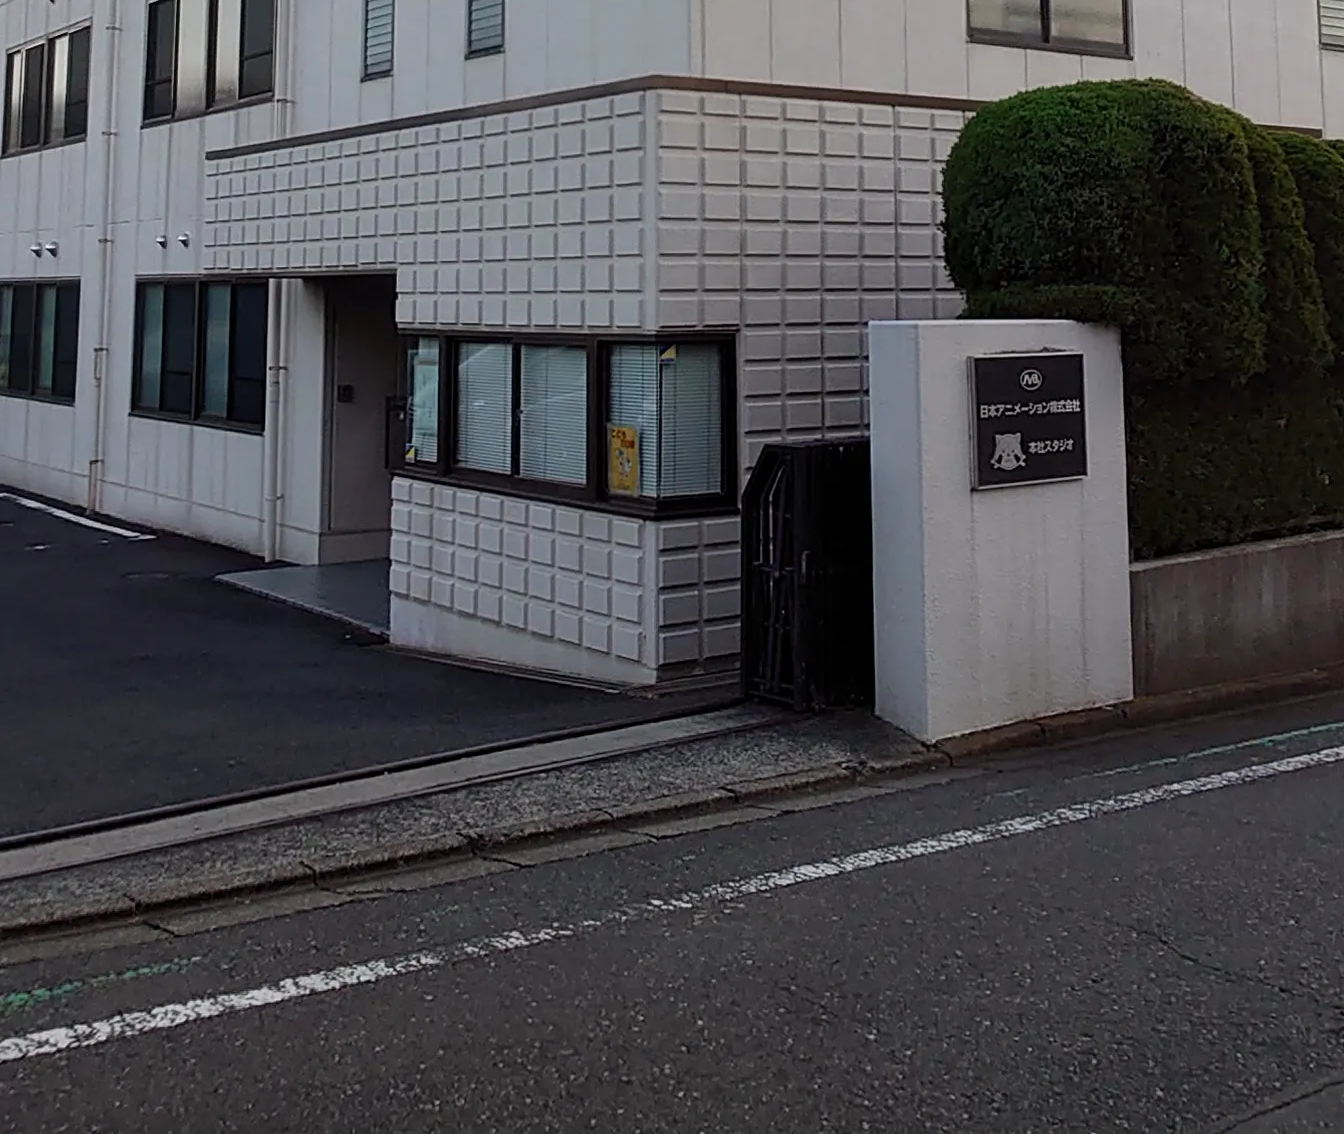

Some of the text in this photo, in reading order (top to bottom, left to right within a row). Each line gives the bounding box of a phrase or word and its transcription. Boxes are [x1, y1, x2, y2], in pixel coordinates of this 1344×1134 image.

[980, 399, 1080, 418] 日本アニメーション株式会社
[1028, 438, 1074, 454] 本社スタジオ
